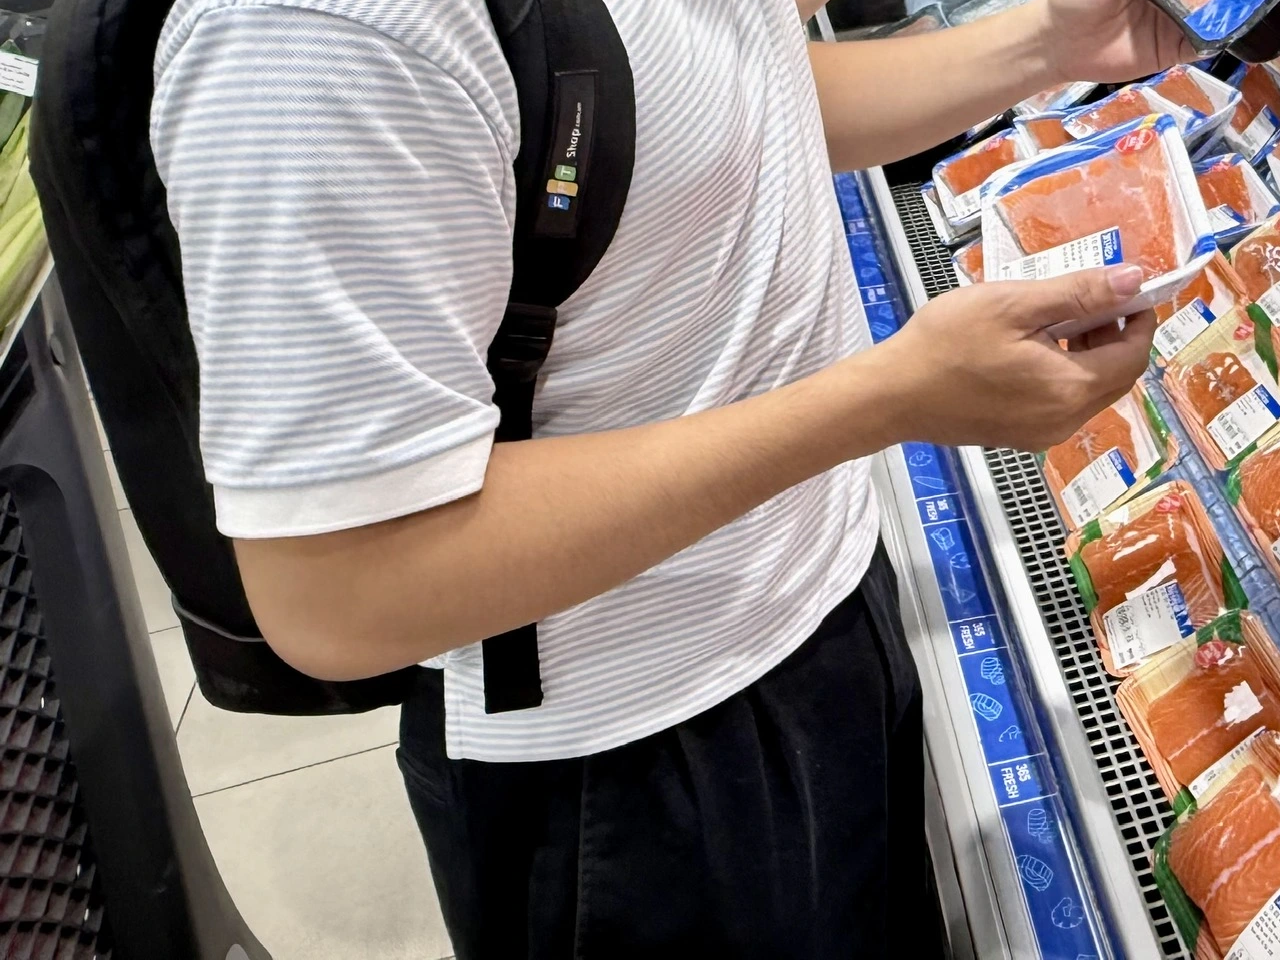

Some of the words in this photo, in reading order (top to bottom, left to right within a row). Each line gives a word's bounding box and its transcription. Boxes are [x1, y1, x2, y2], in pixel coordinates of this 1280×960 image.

[566, 128, 582, 158] Shop
[959, 625, 976, 650] FRESH
[1001, 767, 1020, 799] FRESH
[1015, 763, 1032, 783] 365
